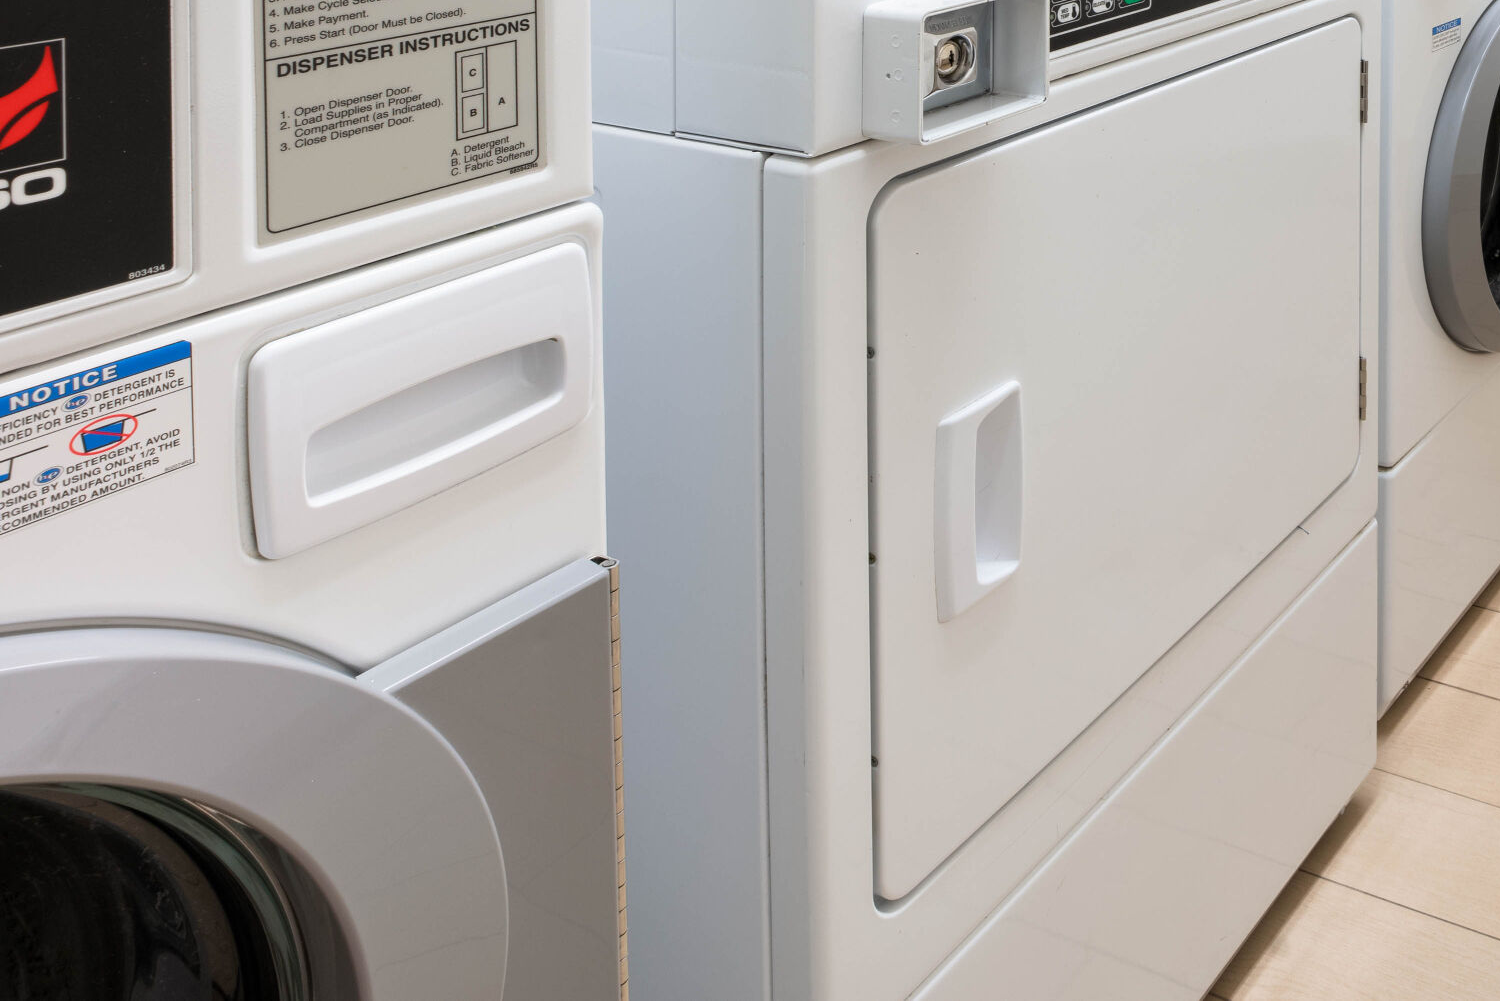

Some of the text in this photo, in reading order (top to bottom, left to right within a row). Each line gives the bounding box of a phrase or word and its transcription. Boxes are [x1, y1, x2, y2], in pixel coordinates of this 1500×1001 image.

[269, 9, 280, 17] 4.
[284, 5, 314, 15] Make
[269, 10, 368, 33] 5. Make Payment.
[270, 7, 466, 48] 6. Press Start (Door Must be Closed).
[276, 19, 530, 77] DISPENSER INSTRUCTIONS
[469, 69, 477, 77] C
[280, 85, 412, 119] 1. Open Dispenser Door.
[280, 93, 422, 130] 2. Load Supplies in Proper
[294, 98, 444, 138] Compartment (as Indicated).
[470, 109, 478, 117] B
[498, 97, 506, 105] A
[280, 115, 414, 151] 3. Close Dispenser Door.
[451, 136, 510, 157] A. Detergent
[451, 141, 525, 167] B. Liquid Bleach
[451, 149, 534, 177] C. Fabric Softener
[128, 264, 166, 279] 803434
[0, 406, 58, 433] FICIENCY
[94, 372, 162, 403] DETERGENT
[166, 369, 176, 379] IS
[9, 364, 118, 411] NOTICE
[36, 417, 61, 433] FOR
[65, 407, 95, 423] BEST
[100, 377, 184, 413] PERFORMANCE
[2, 481, 30, 497] NON
[66, 442, 143, 475] DETERGENT,
[146, 428, 180, 446] AVOID
[42, 482, 58, 495] BY
[62, 468, 100, 487] USING
[104, 455, 136, 472] ONLY
[140, 448, 156, 459] 1/2
[158, 438, 181, 452] THE
[50, 457, 160, 503] MANUFACTURERS
[0, 473, 145, 531] COMMENDED AMOUNT.
